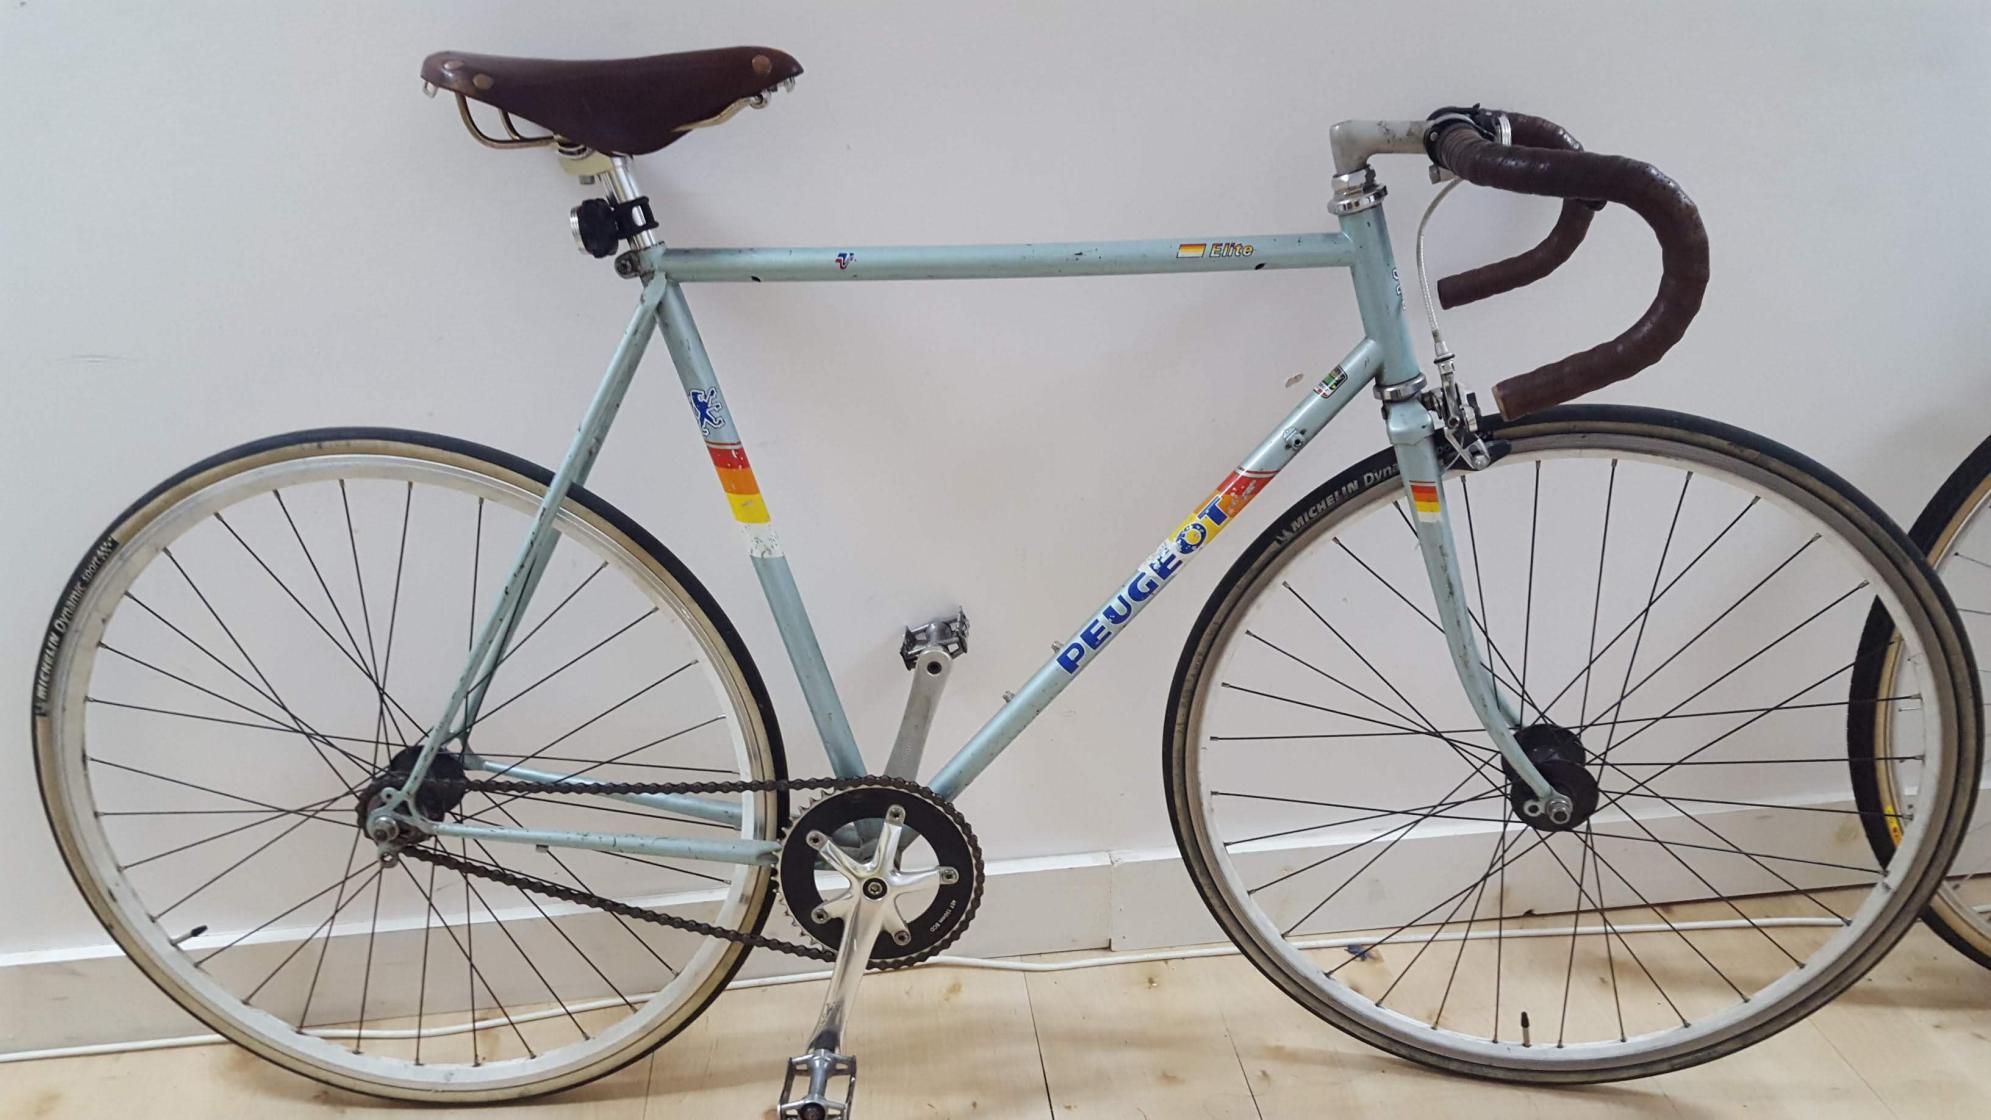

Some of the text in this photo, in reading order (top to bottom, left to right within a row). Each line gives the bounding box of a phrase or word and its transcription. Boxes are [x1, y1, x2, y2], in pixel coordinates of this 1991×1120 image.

[1209, 242, 1255, 258] Elite
[1291, 463, 1401, 531] MICHELIN Dyna
[1056, 495, 1228, 675] PEUGEOT
[36, 632, 60, 700] MICHELIN
[54, 585, 85, 629] Dynamic
